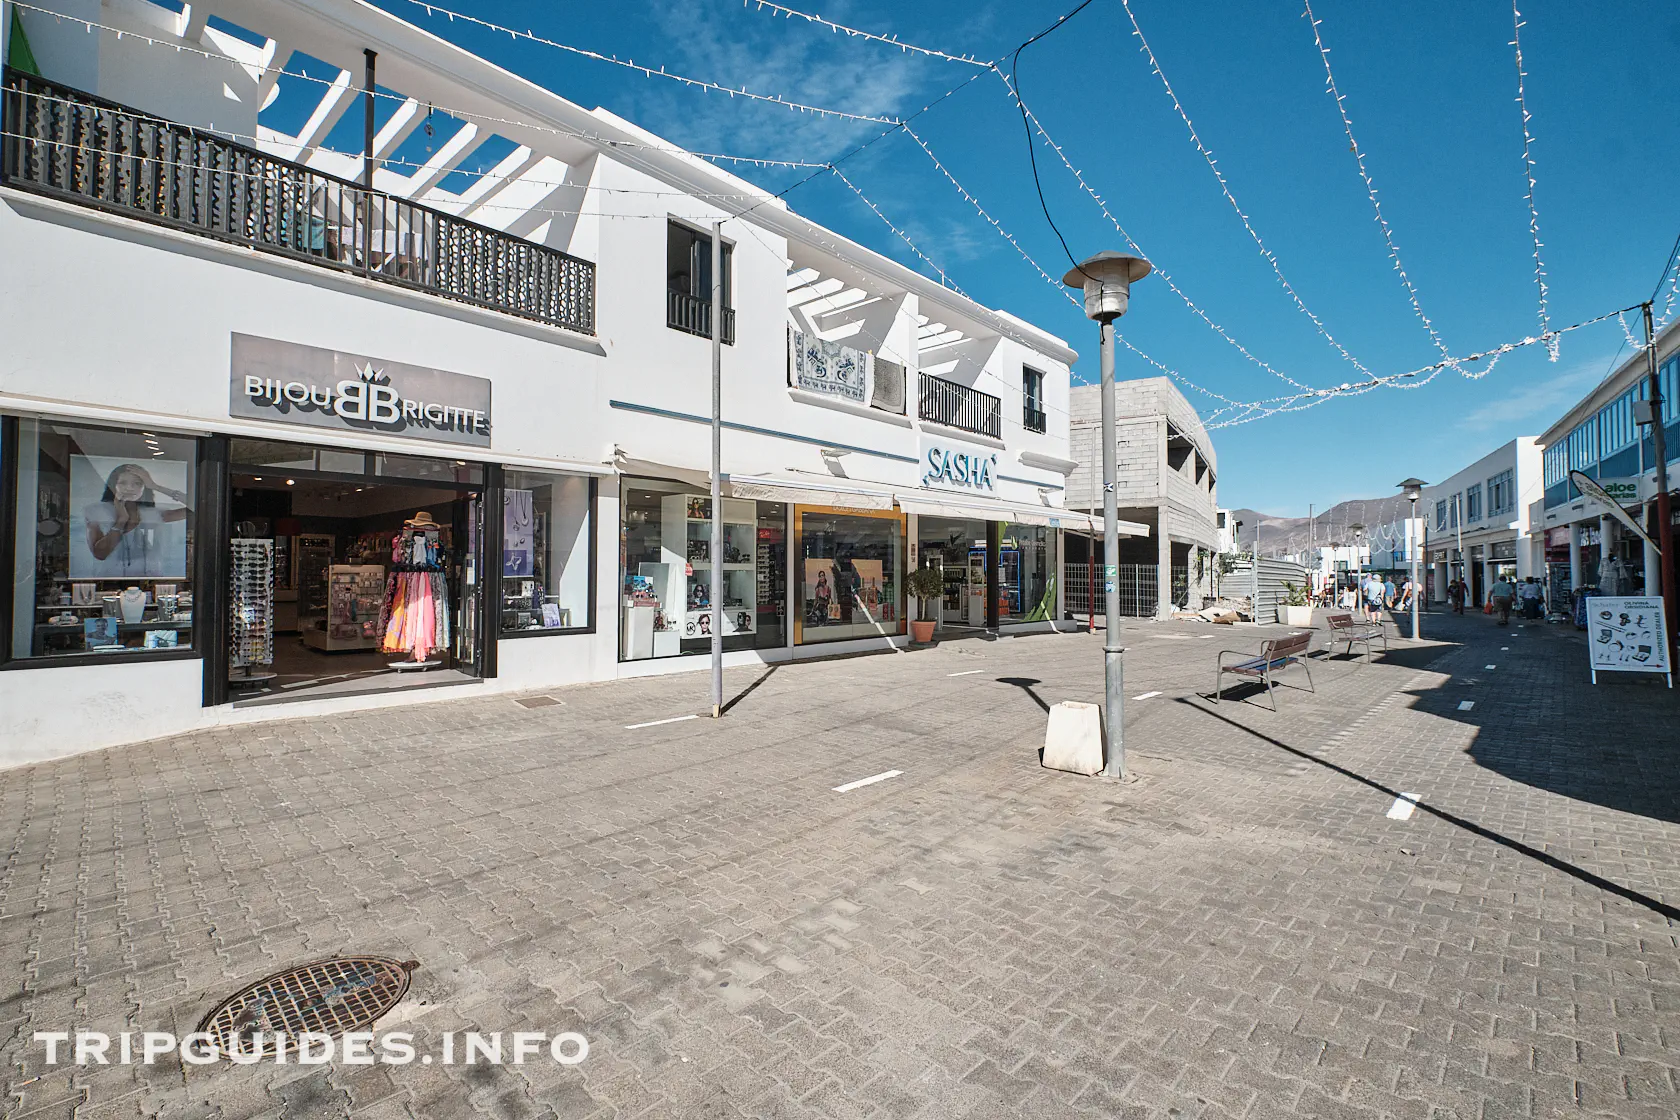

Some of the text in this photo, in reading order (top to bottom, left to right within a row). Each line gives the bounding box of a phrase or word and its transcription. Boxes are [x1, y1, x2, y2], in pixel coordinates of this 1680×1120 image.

[244, 375, 332, 407] BIJOU
[928, 447, 995, 489] SASHA
[1604, 483, 1636, 492] aloe
[1654, 612, 1665, 662] AUTHORIZED DEALER
